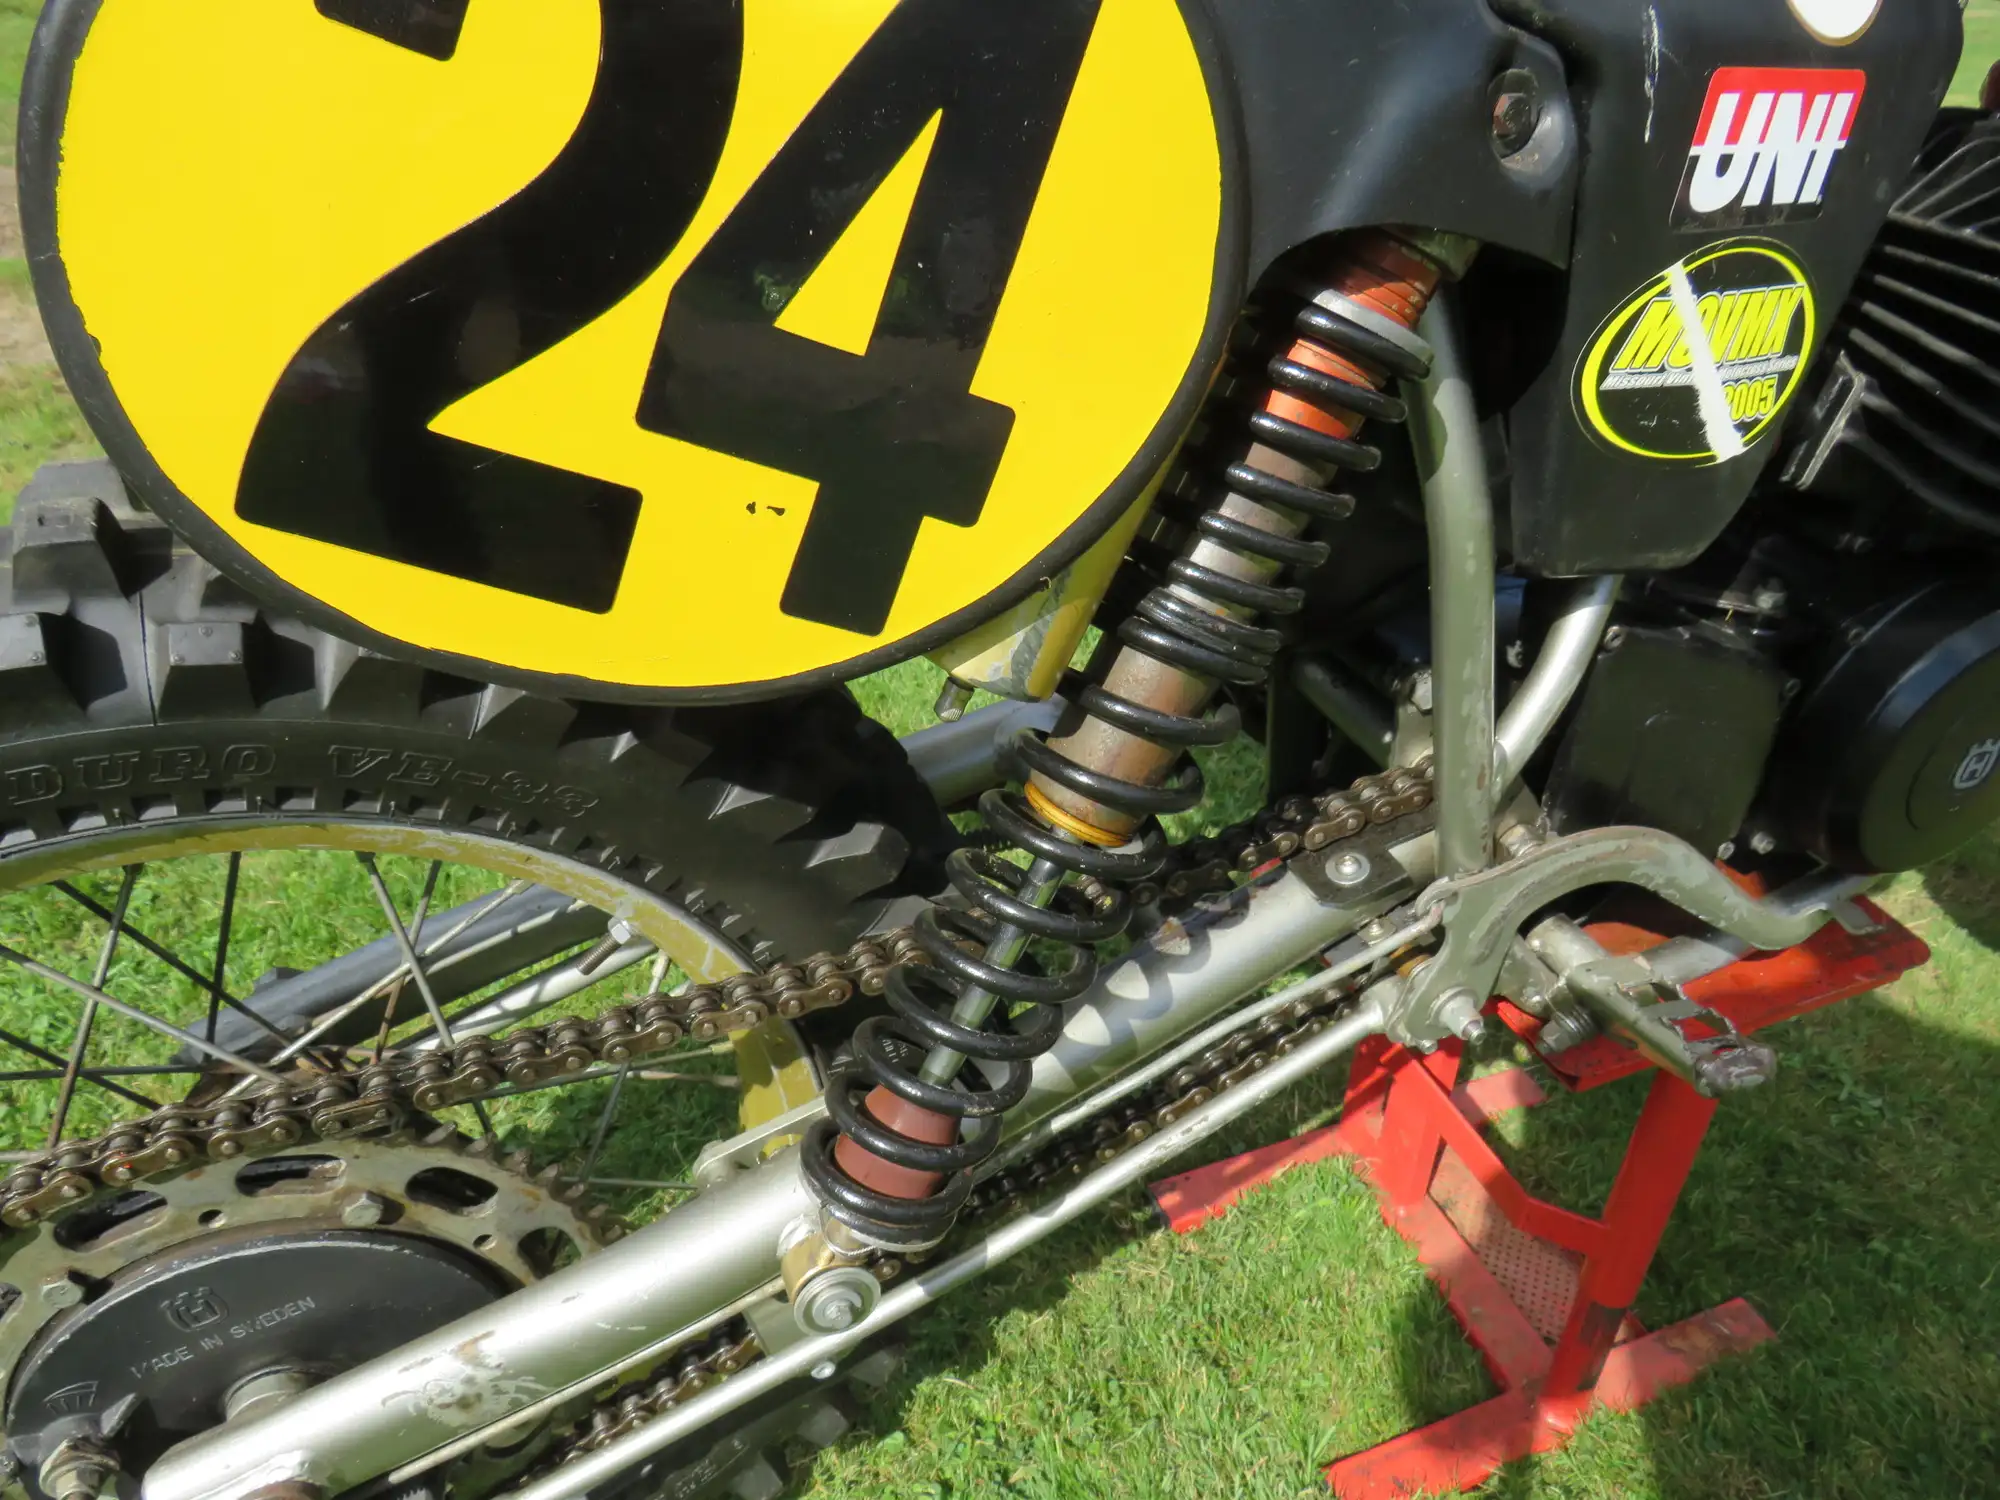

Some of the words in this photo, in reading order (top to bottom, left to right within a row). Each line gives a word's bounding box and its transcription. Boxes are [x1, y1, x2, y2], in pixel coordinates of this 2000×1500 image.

[1689, 92, 1854, 213] UNI
[235, 0, 1103, 636] 24
[4, 743, 276, 805] DURO
[129, 1345, 195, 1380] MADE
[201, 1333, 224, 1352] IN
[229, 1295, 316, 1340] SWEDEN
